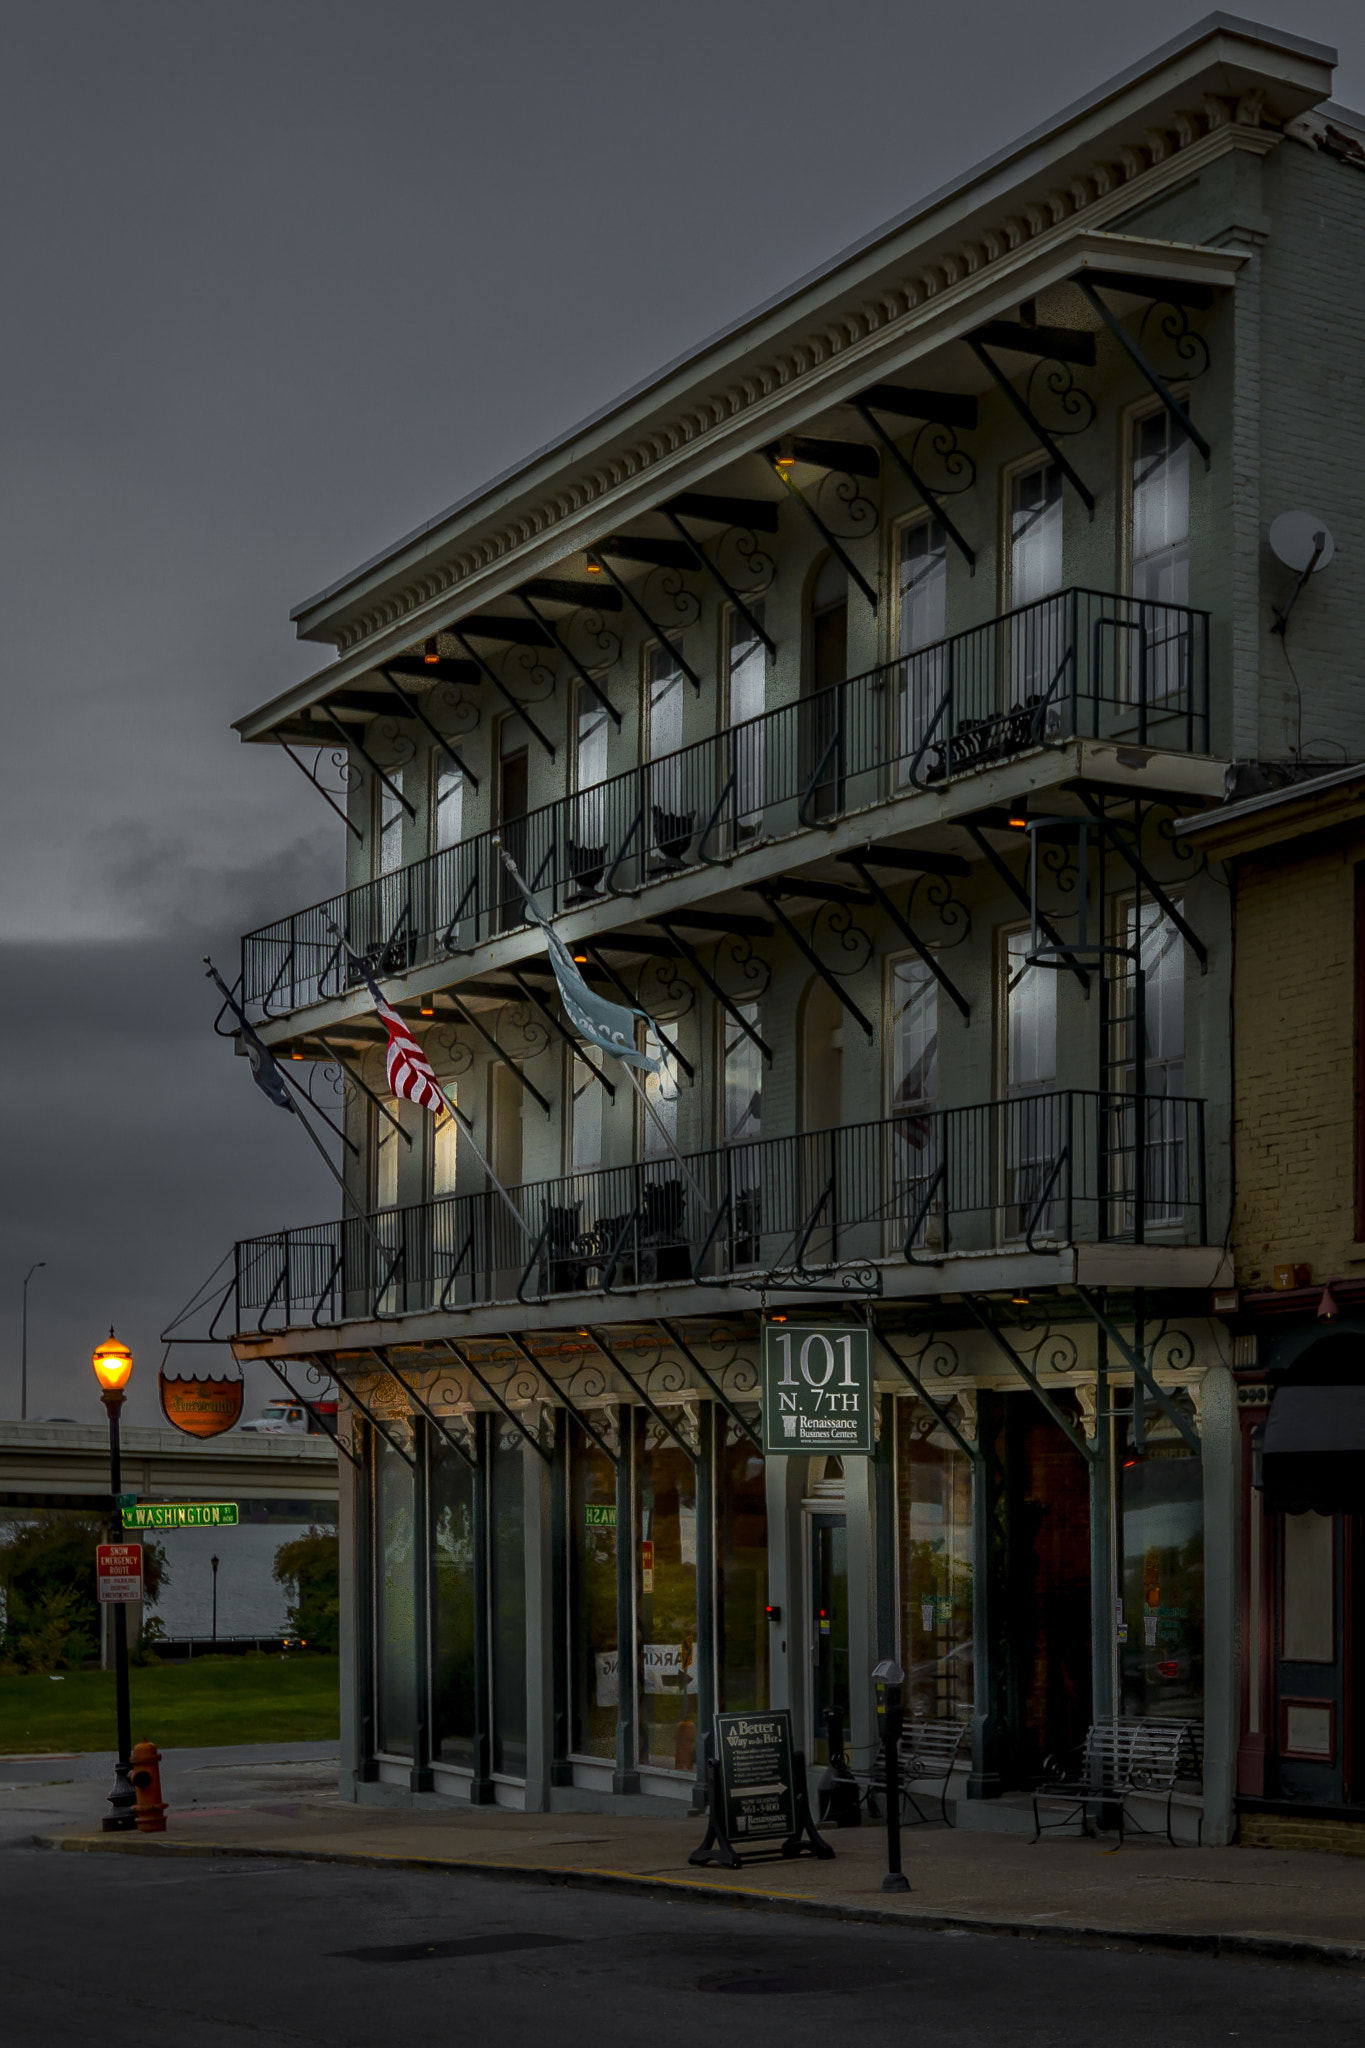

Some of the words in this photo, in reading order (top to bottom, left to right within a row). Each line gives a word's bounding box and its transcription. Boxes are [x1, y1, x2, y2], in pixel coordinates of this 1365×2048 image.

[775, 1333, 860, 1387] 101
[778, 1392, 803, 1411] N.
[810, 1388, 860, 1412] 7TH
[799, 1415, 858, 1429] Renaissance
[799, 1428, 830, 1438] Business
[830, 1429, 858, 1438] Centers
[126, 1512, 133, 1522] W
[136, 1507, 220, 1525] WASHINGTON
[110, 1547, 129, 1556] SNOW
[101, 1556, 138, 1566] EMERGENCY
[109, 1565, 130, 1575] ROUTE
[729, 1726, 738, 1736] A
[738, 1721, 775, 1736] Better
[726, 1735, 748, 1749] Way
